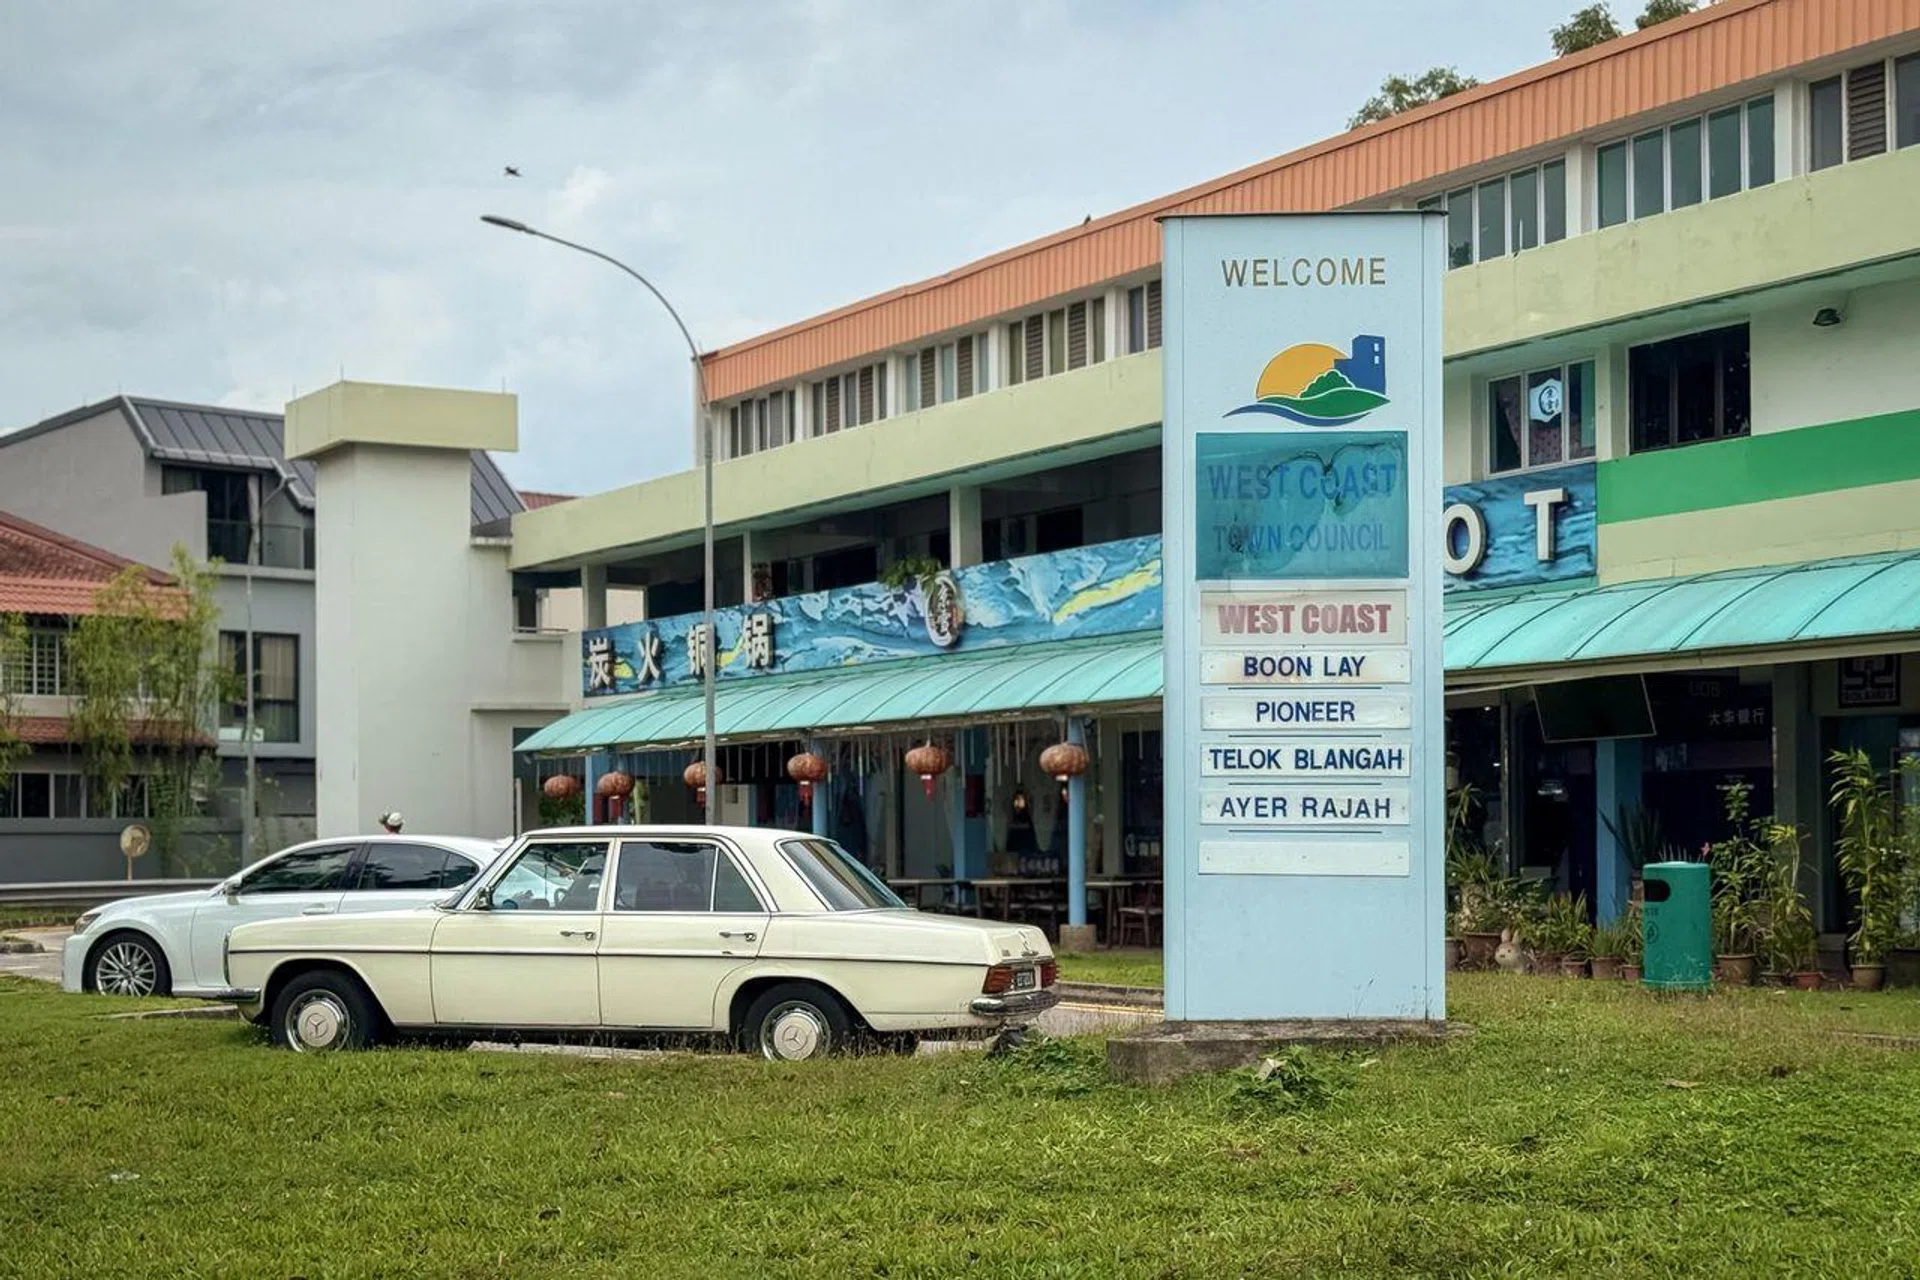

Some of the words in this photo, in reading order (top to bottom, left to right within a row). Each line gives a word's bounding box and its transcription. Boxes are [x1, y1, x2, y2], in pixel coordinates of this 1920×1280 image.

[1222, 257, 1386, 287] WELCOME
[1208, 464, 1291, 500] WEST
[1301, 463, 1396, 499] COAST
[1213, 525, 1282, 554] TOWN
[1289, 524, 1391, 552] COUNCIL
[1218, 604, 1295, 634] WEST
[1302, 604, 1392, 633] COAST
[1244, 656, 1312, 677] BOON
[1323, 656, 1366, 677] LAY
[1256, 701, 1356, 722] PIONEER
[1209, 749, 1282, 770] TELOK
[1294, 749, 1402, 770] BLANGAH
[1219, 797, 1288, 818] AYER
[1301, 797, 1391, 819] RAJAH
